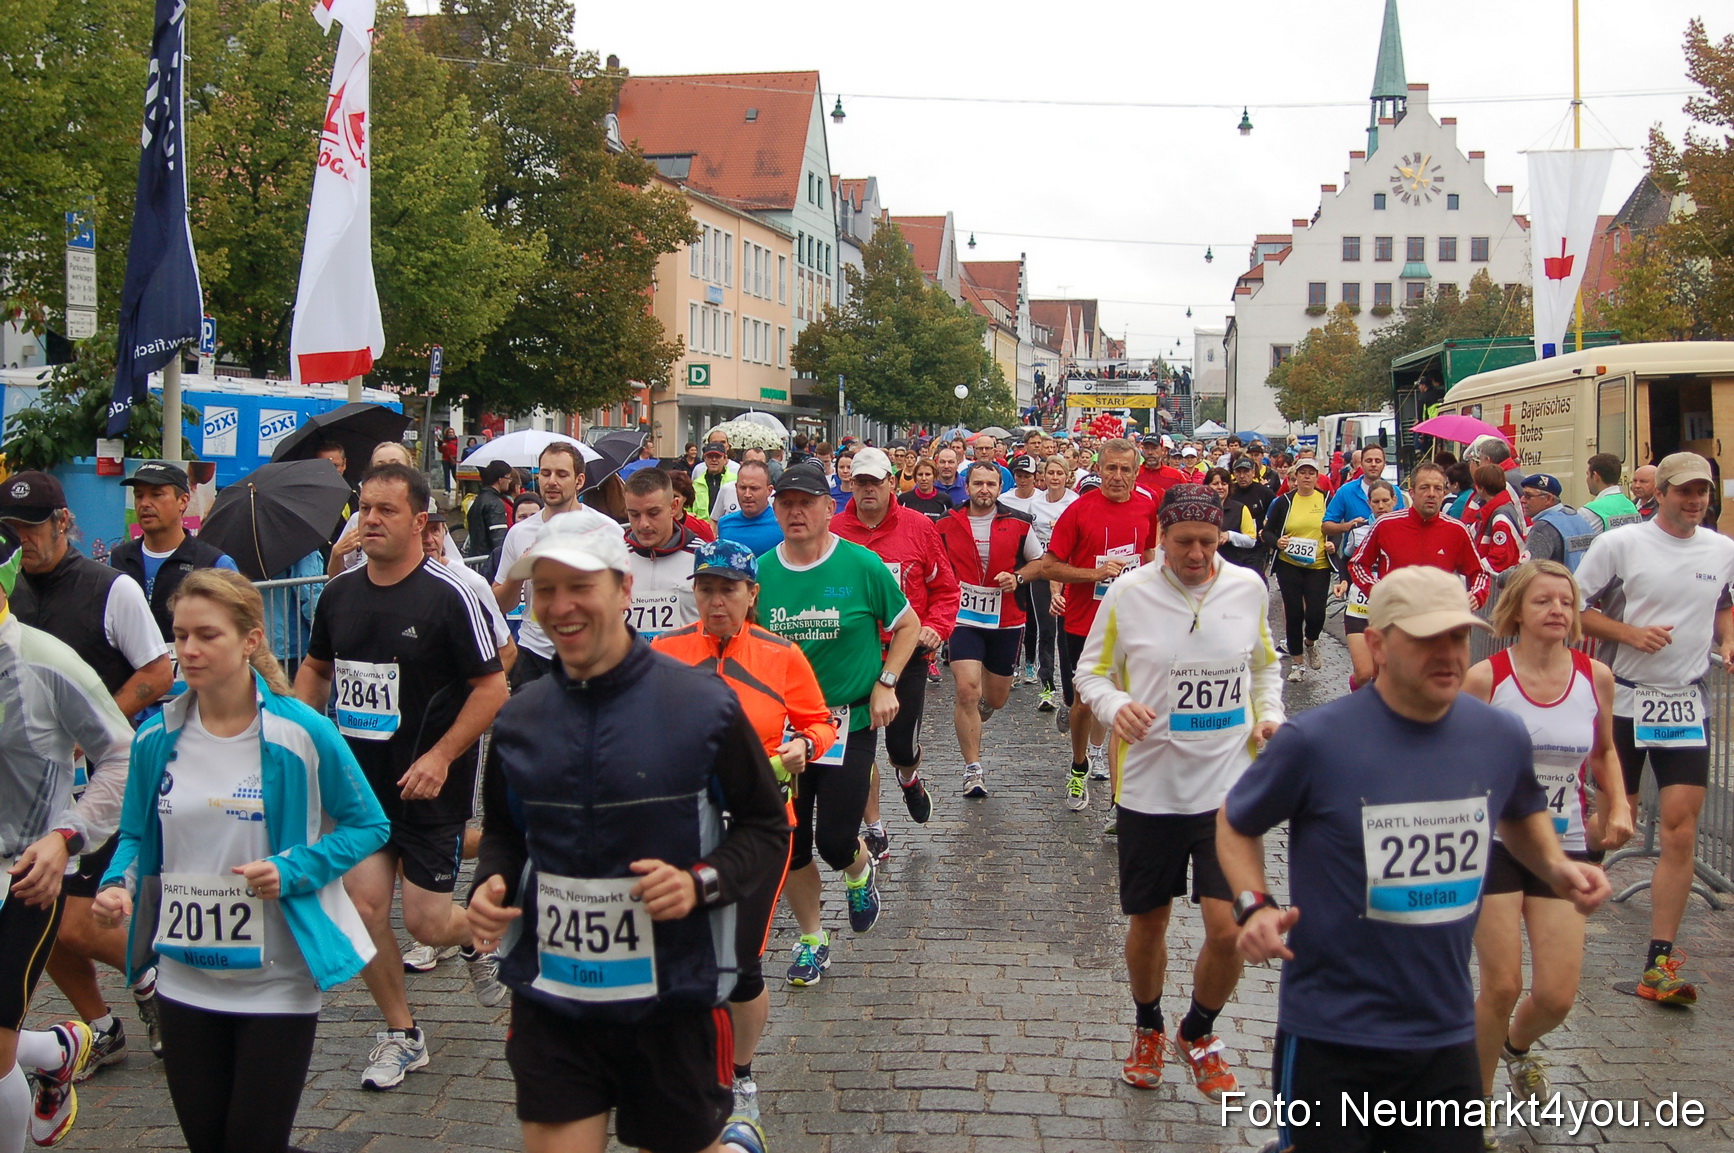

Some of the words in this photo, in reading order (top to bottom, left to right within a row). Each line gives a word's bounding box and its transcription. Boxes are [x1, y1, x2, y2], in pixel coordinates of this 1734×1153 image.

[203, 321, 212, 349] P
[434, 351, 441, 372] P
[691, 366, 707, 383] D
[1095, 397, 1127, 406] START
[1521, 396, 1571, 423] Bayerisches
[1519, 424, 1544, 443] Rotes
[1518, 448, 1542, 466] Kreuz
[1287, 543, 1314, 557] 2352
[636, 596, 668, 604] Neumarkt
[961, 593, 996, 612] 3111
[622, 604, 674, 629] 2712
[769, 606, 790, 624] 30.
[769, 619, 840, 632] REGENSBURGER
[774, 628, 841, 643] ltstadtlauf
[1170, 669, 1199, 678] PARTL
[1201, 666, 1238, 677] Neumarkt
[341, 678, 391, 711] 2841
[1177, 677, 1242, 710] 2674
[1641, 700, 1696, 723] 2203
[347, 714, 379, 728] Ronald
[1190, 716, 1232, 732] Rüdiger
[1654, 728, 1686, 739] Roland
[1366, 817, 1411, 830] PARTL
[1413, 813, 1471, 827] Neumarkt
[1380, 829, 1479, 880] 2252
[163, 883, 189, 896] PARTL
[190, 885, 241, 898] Neumarkt
[539, 883, 565, 900] PARTL
[566, 891, 624, 903] Neumarkt
[1408, 889, 1457, 908] Stefan
[166, 900, 252, 941] 2012
[546, 904, 640, 954] 2454
[184, 951, 229, 967] Nicole
[571, 964, 604, 984] Toni
